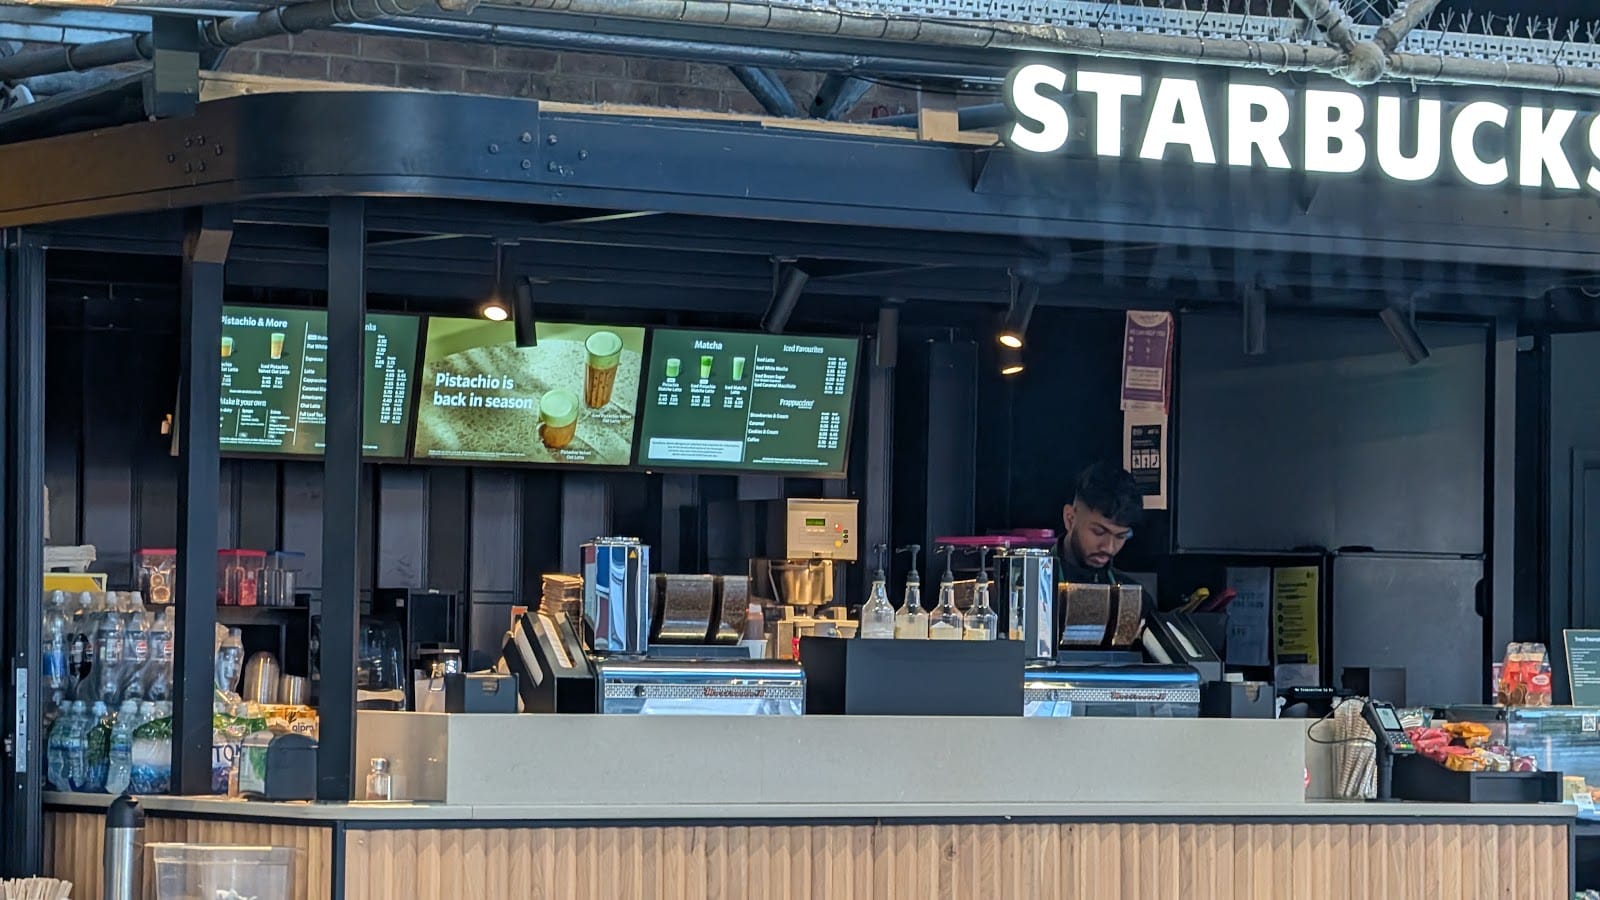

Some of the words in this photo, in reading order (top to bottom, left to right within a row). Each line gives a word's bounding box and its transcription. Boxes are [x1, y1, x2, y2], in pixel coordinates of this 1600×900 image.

[1010, 63, 1600, 191] STARBUCK
[257, 317, 264, 327] &
[265, 318, 288, 328] More
[694, 340, 723, 350] Matcha
[783, 344, 795, 353] Iced
[795, 345, 824, 354] Favourites
[435, 372, 500, 389] Pistachio
[502, 375, 514, 389] is
[433, 391, 466, 407] back
[469, 392, 483, 407] in
[485, 397, 534, 409] season
[779, 398, 813, 408] Frappuccino
[292, 722, 314, 732] alpro
